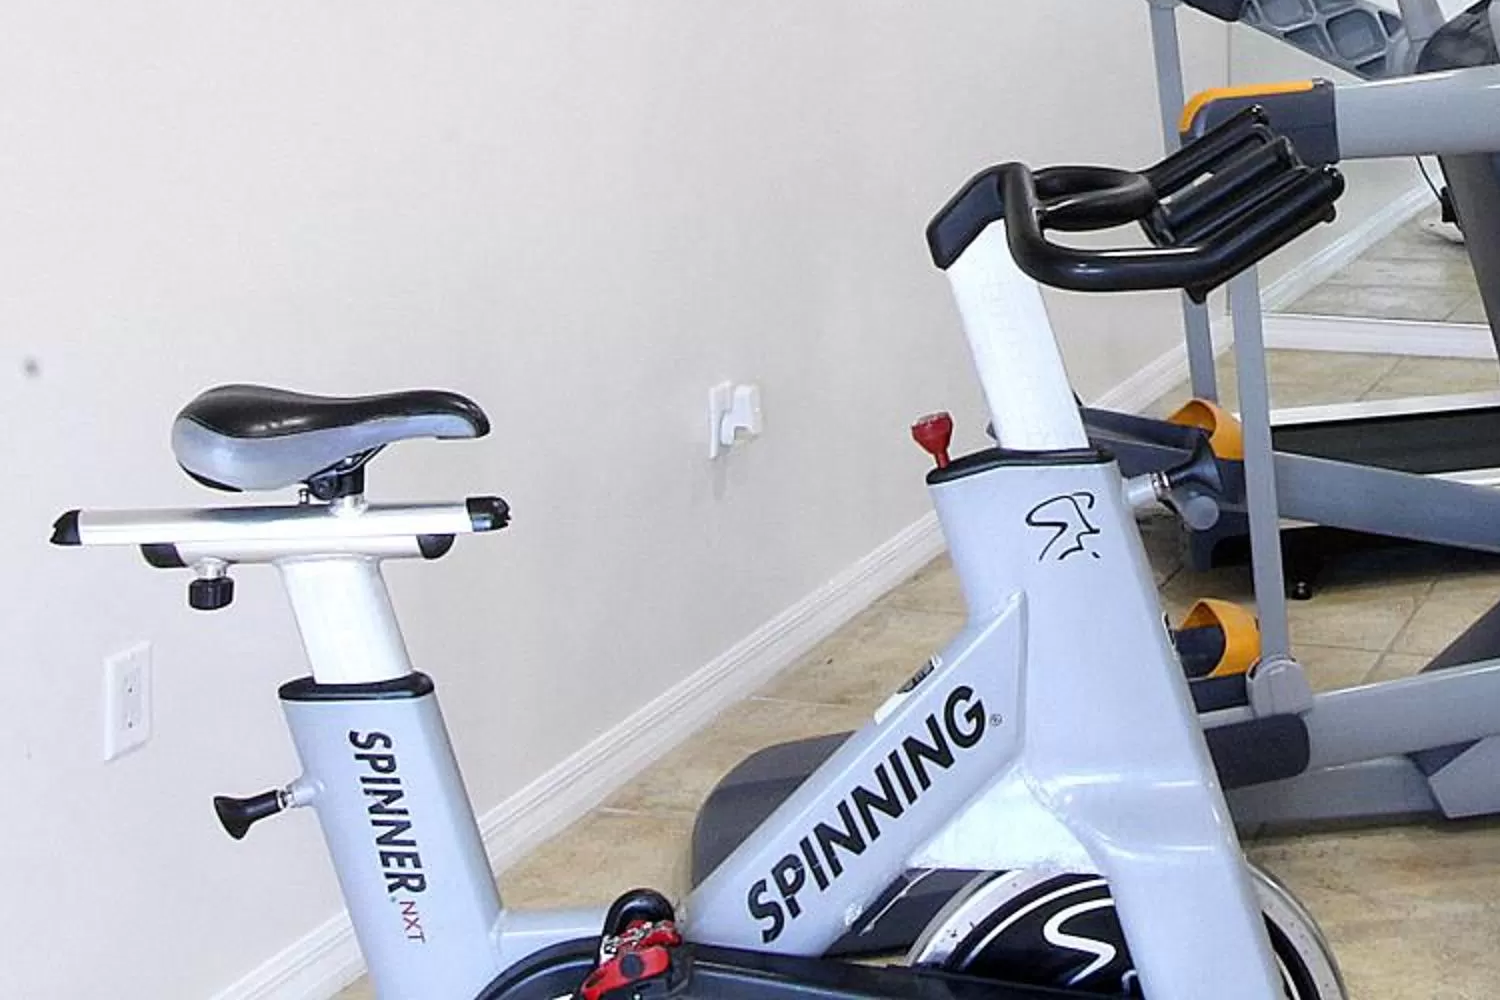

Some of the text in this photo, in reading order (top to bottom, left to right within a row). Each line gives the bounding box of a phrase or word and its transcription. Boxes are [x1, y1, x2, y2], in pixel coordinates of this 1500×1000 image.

[349, 730, 427, 944] SPINNER NXT
[748, 685, 987, 943] SPINNING
